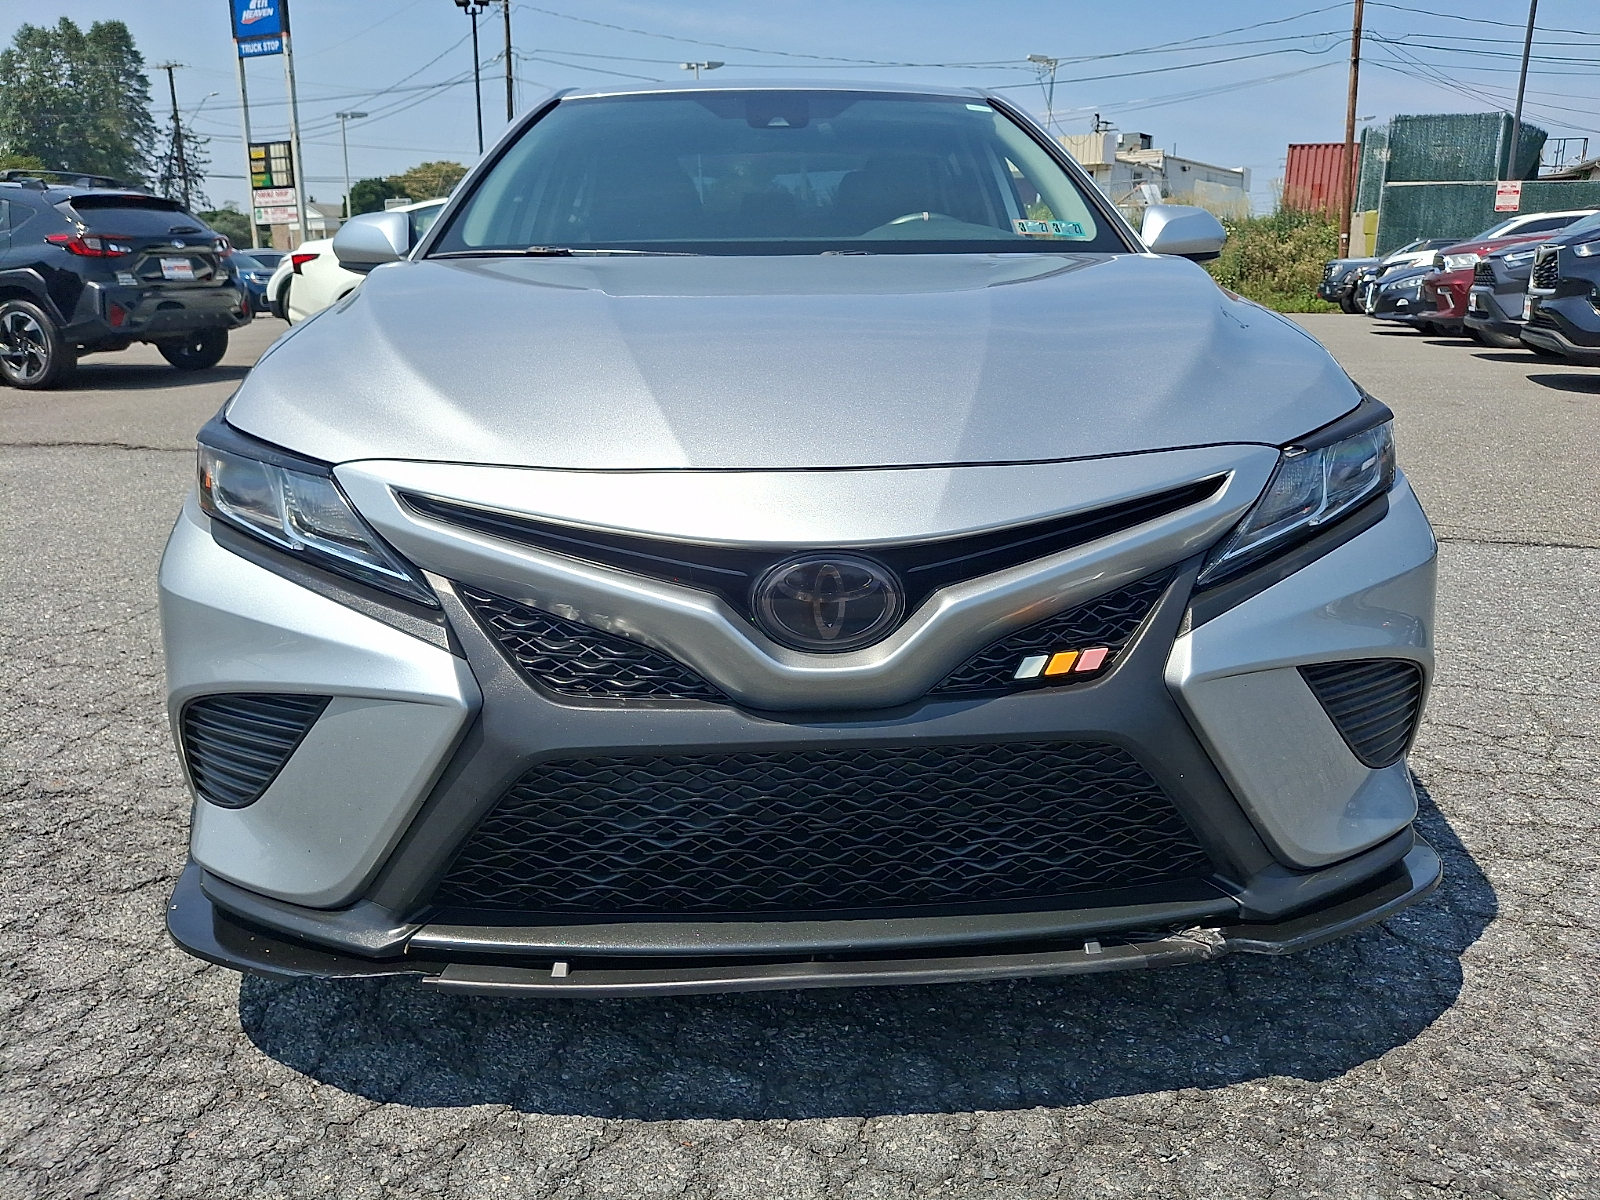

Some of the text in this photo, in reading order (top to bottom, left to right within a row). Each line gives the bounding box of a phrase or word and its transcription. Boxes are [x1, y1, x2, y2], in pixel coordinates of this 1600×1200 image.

[242, 8, 274, 21] HEAVEN
[241, 40, 279, 54] TRUCK STOP
[1018, 222, 1048, 232] 3 27
[1053, 222, 1082, 234] 3 27
